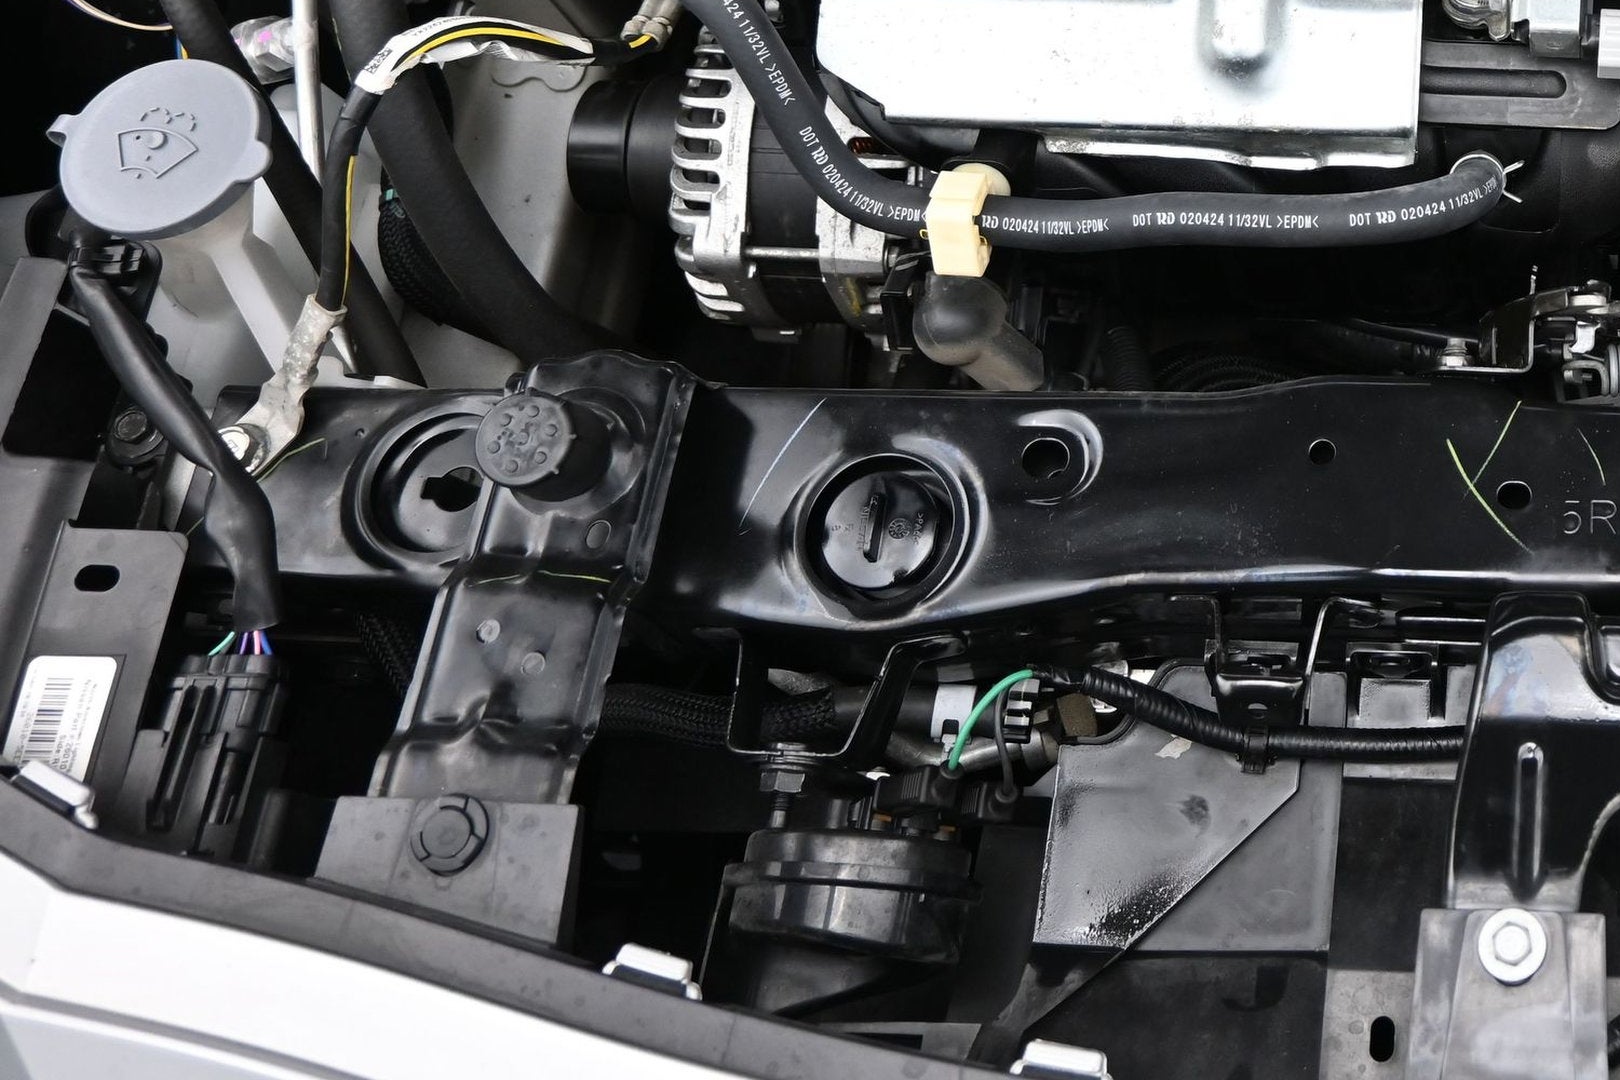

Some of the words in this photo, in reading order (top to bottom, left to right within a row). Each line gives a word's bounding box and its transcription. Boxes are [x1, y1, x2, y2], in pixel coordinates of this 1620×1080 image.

[799, 126, 820, 147] DOT
[822, 164, 854, 198] 020424
[1132, 213, 1152, 227] DOT
[1180, 212, 1225, 227] 020424
[1349, 213, 1371, 227] DOT
[1400, 203, 1446, 222] 020424
[1002, 217, 1039, 234] 020424
